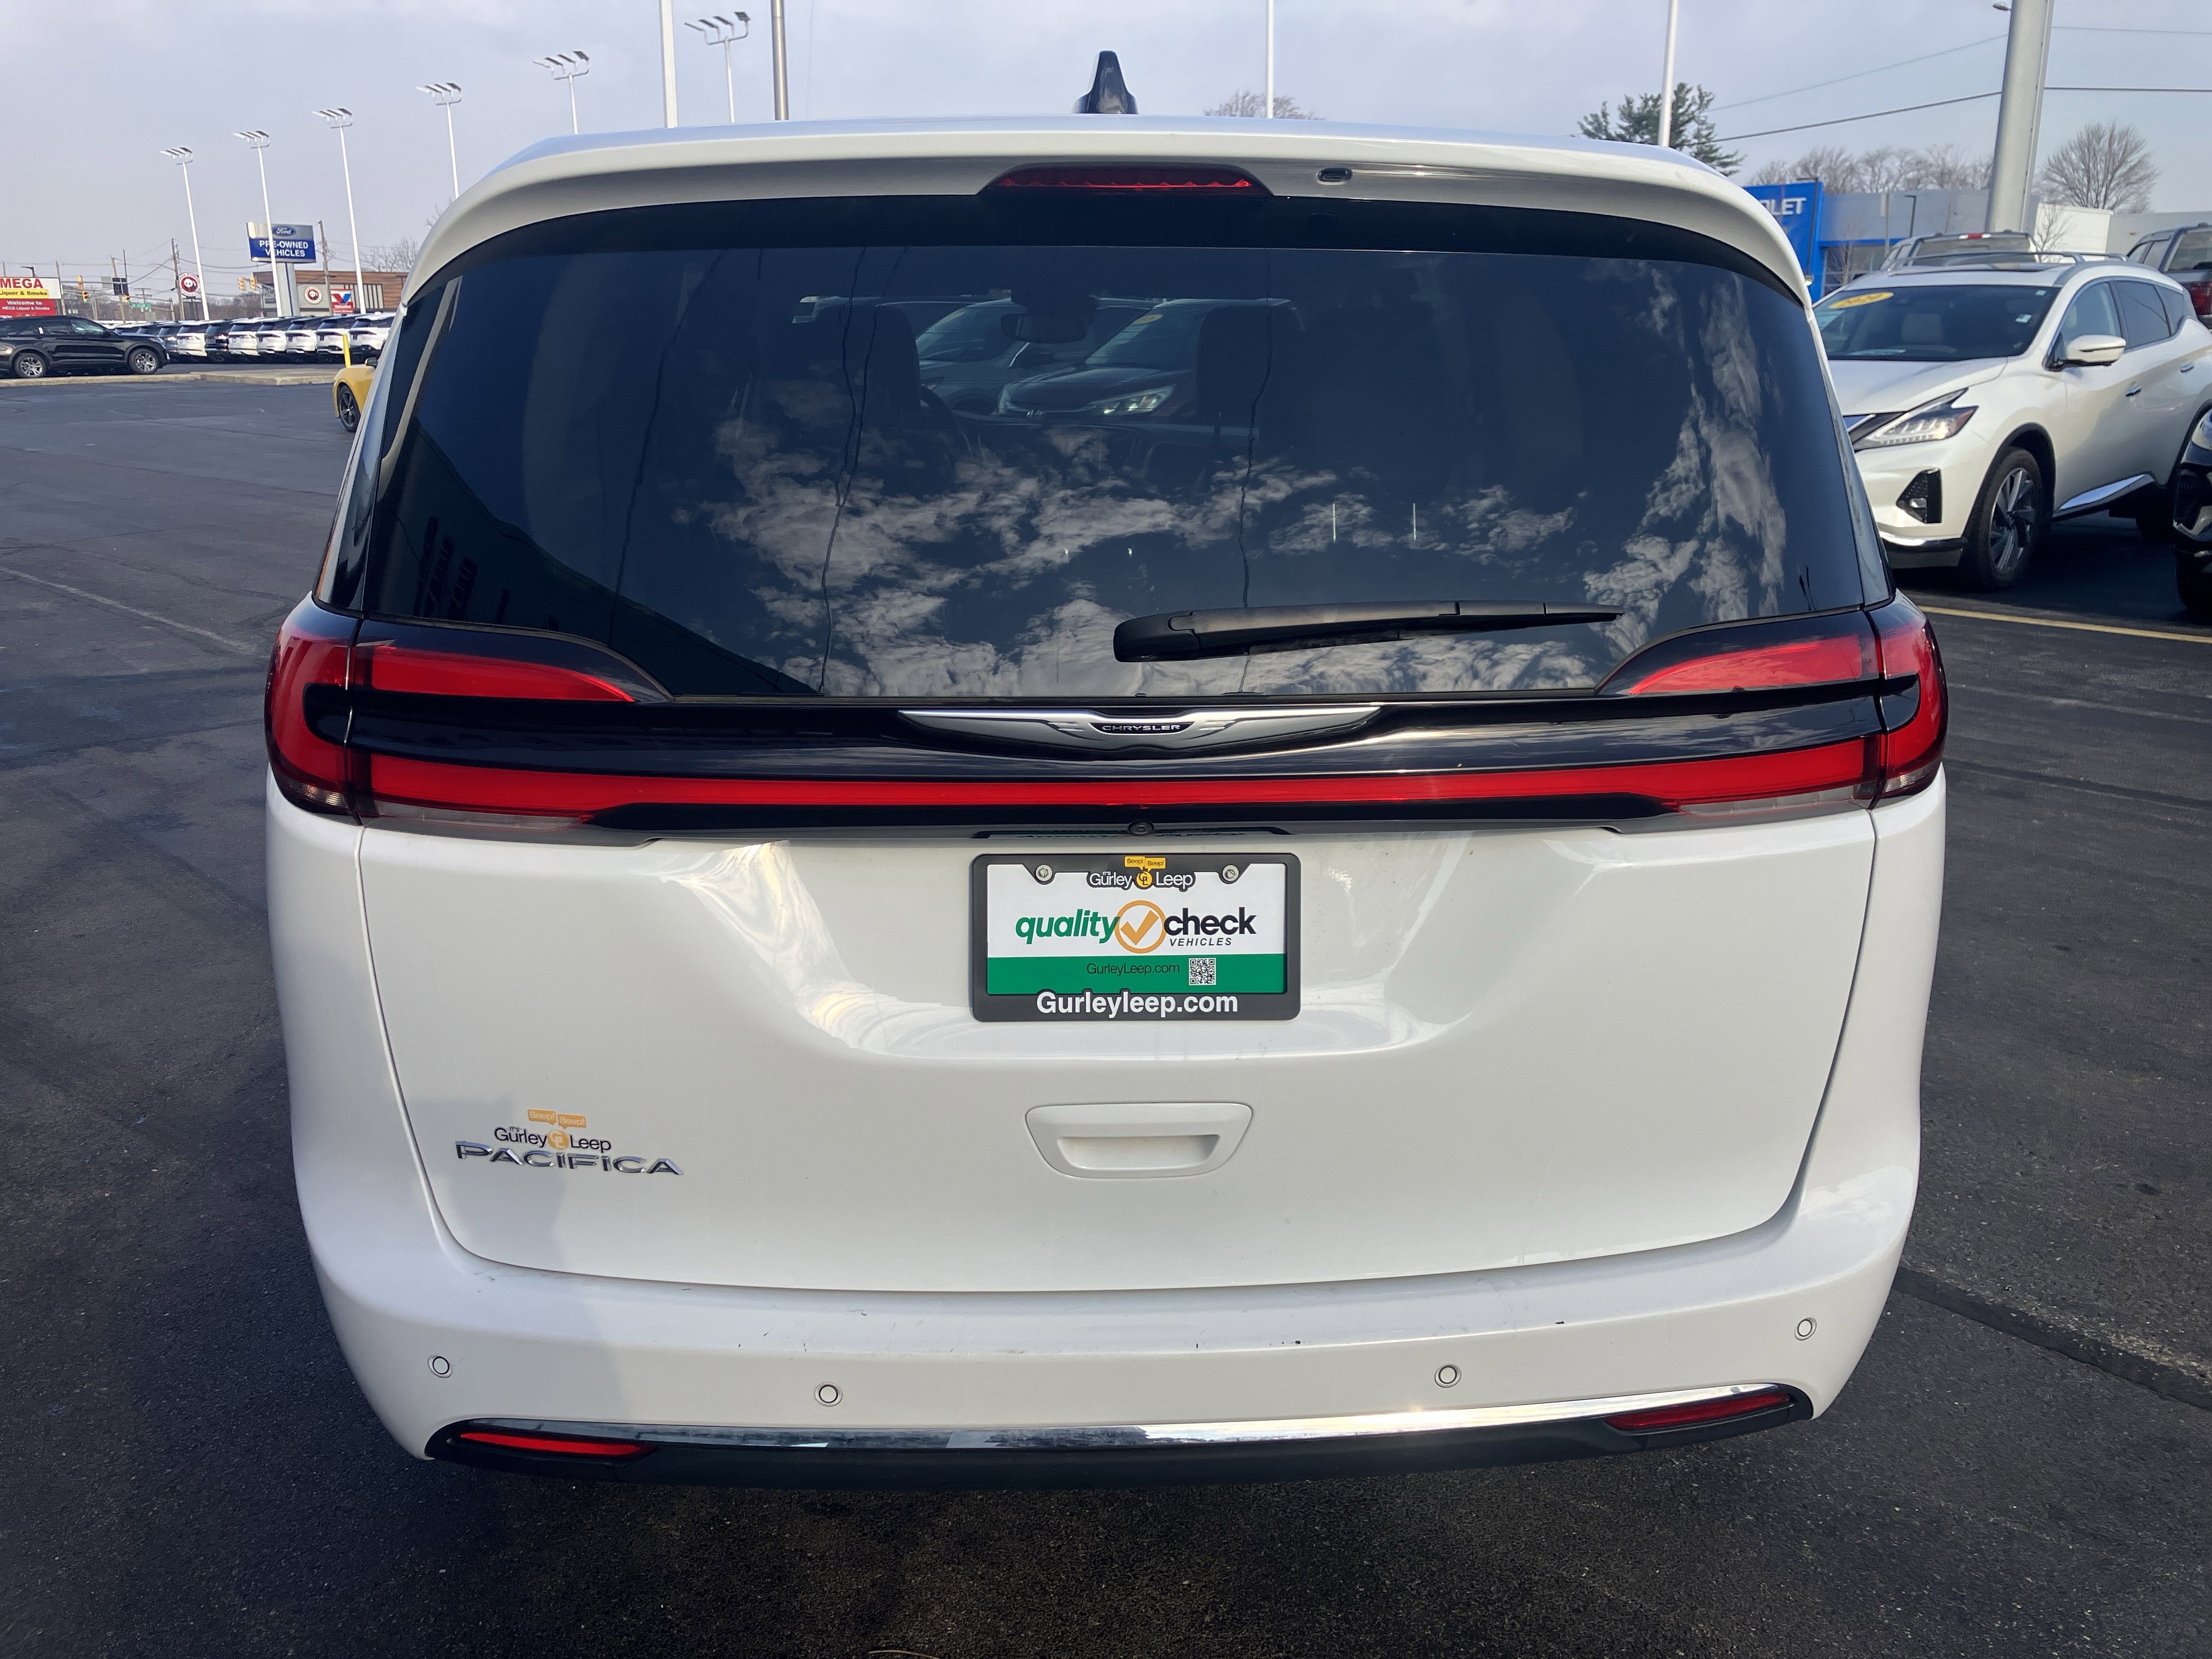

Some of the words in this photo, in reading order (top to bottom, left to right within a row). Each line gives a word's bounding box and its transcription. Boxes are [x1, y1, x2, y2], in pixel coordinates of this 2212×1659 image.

[0, 278, 43, 289] MEGA
[1090, 871, 1132, 889] Gurley
[1156, 871, 1193, 890] Leep
[1015, 909, 1120, 944] quality
[1164, 907, 1257, 936] check
[1170, 938, 1232, 946] VEHICLES
[1087, 963, 1180, 977] GurleyLeep.com
[1036, 991, 1238, 1019] Gurleyleep.com
[529, 1111, 555, 1120] Beep!
[559, 1117, 585, 1125] Beep!
[494, 1127, 548, 1148] Gurley
[569, 1135, 612, 1153] Leep
[455, 1141, 684, 1175] PACIFICA
